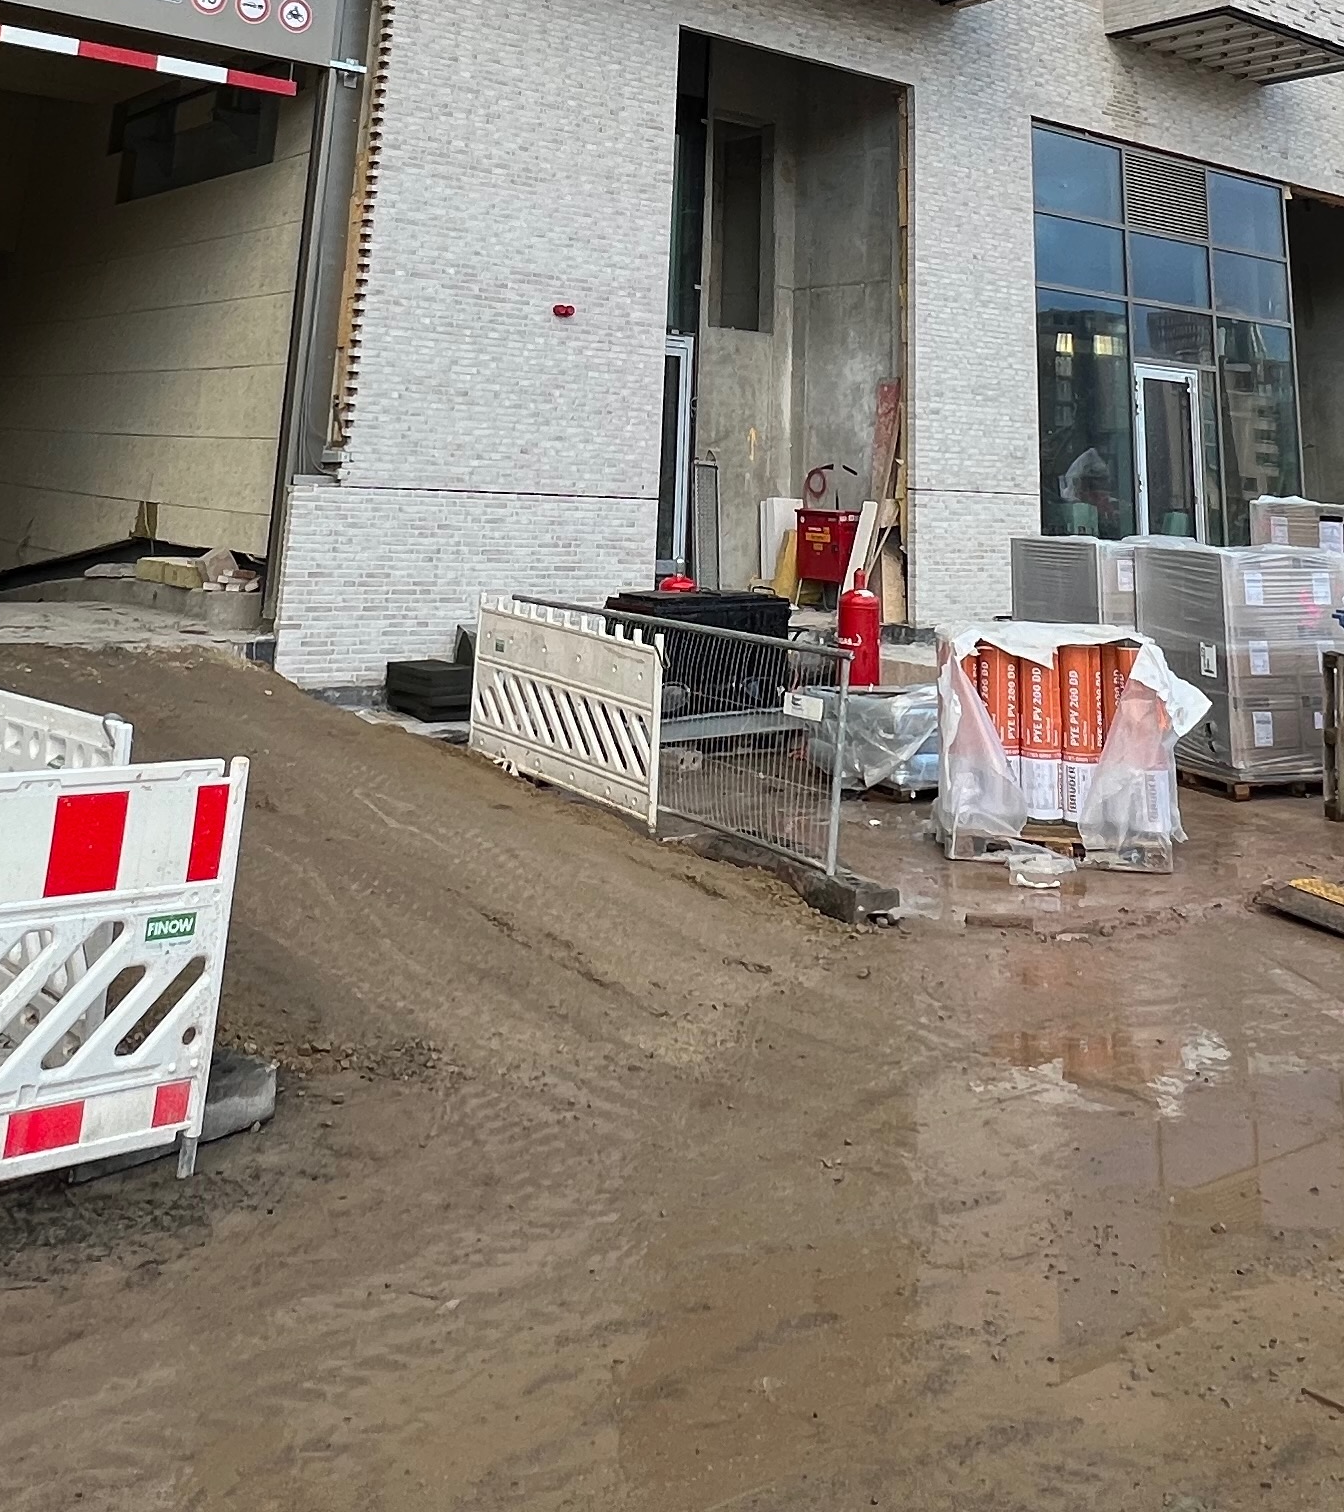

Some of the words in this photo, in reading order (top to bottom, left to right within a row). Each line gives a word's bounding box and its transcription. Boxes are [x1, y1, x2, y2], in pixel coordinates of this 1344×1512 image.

[1032, 667, 1041, 682] DD
[1069, 670, 1079, 686] DD
[1033, 684, 1042, 705] 200
[1069, 687, 1079, 708] 200
[1007, 703, 1015, 718] PV
[1033, 706, 1042, 721] PV
[1069, 708, 1079, 724] PV
[1033, 722, 1042, 743] PYE
[1070, 726, 1079, 747] PYE
[147, 917, 194, 937] FINOW
